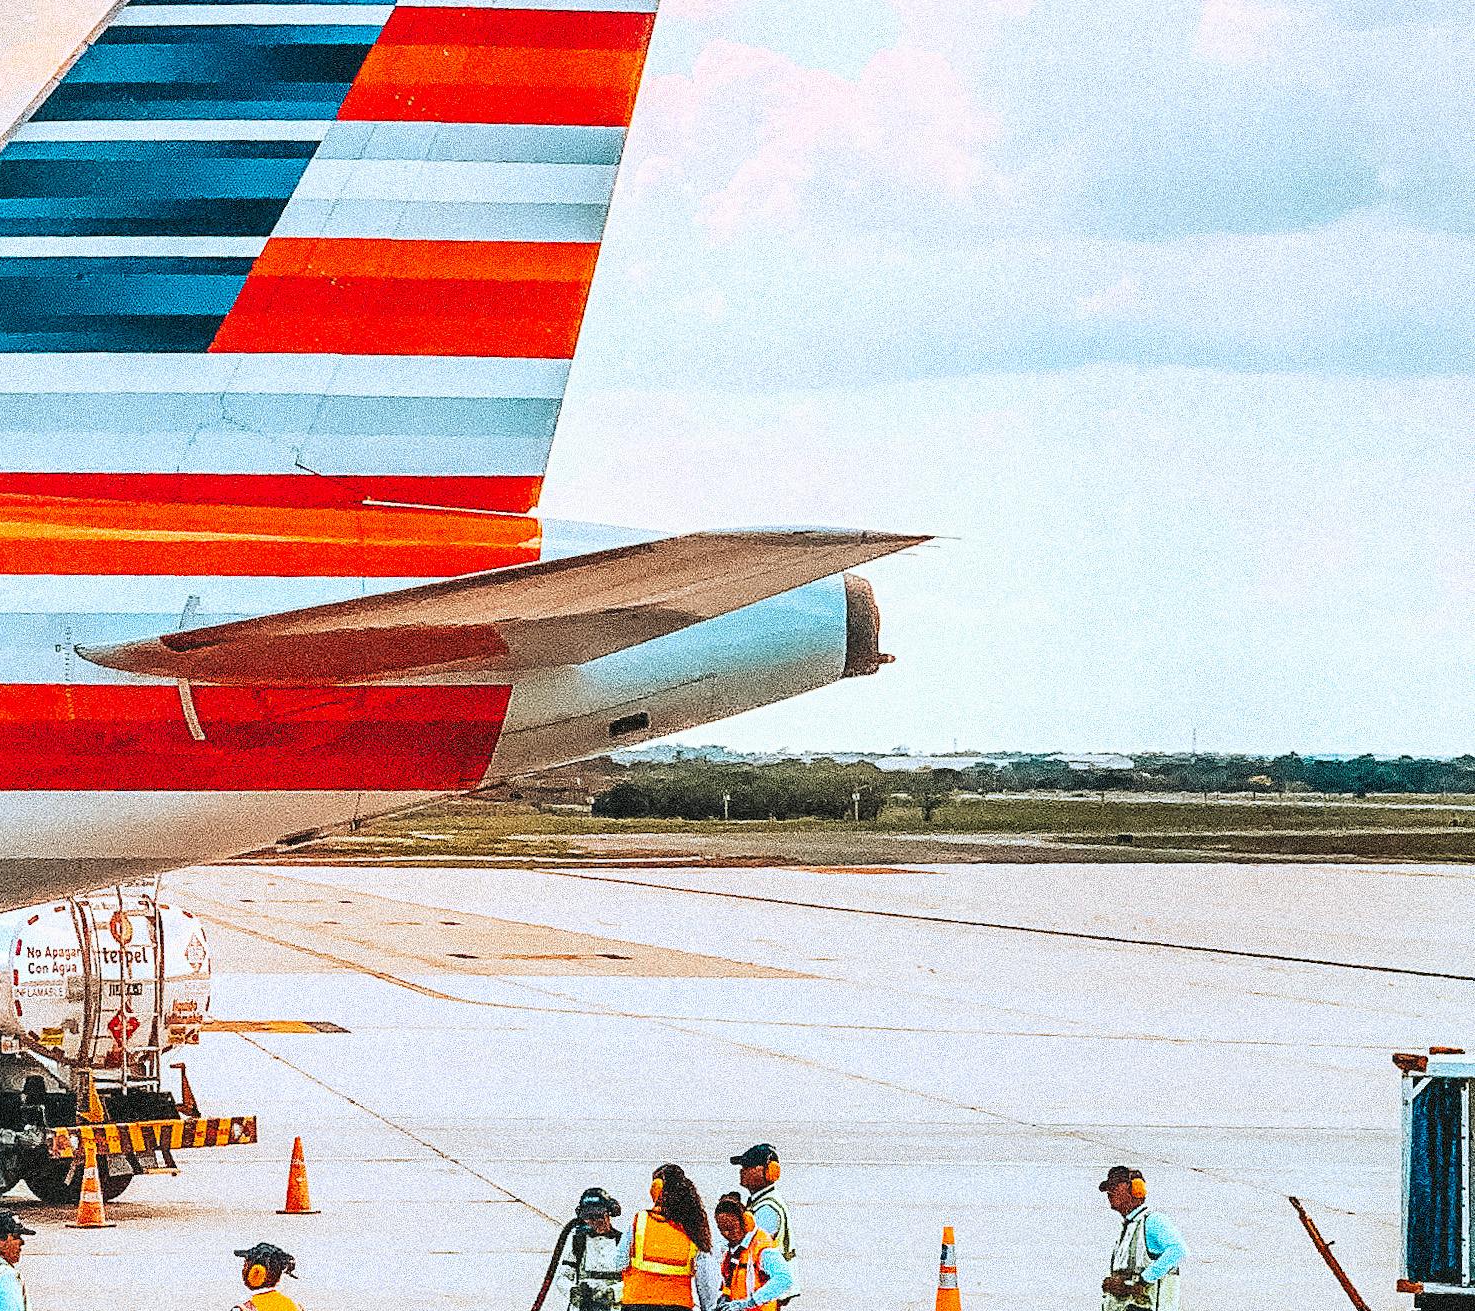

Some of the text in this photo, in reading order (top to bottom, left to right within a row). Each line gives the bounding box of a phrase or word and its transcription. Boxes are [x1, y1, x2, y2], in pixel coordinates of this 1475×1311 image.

[27, 946, 81, 961] No Apagar
[28, 961, 77, 977] Con Agua
